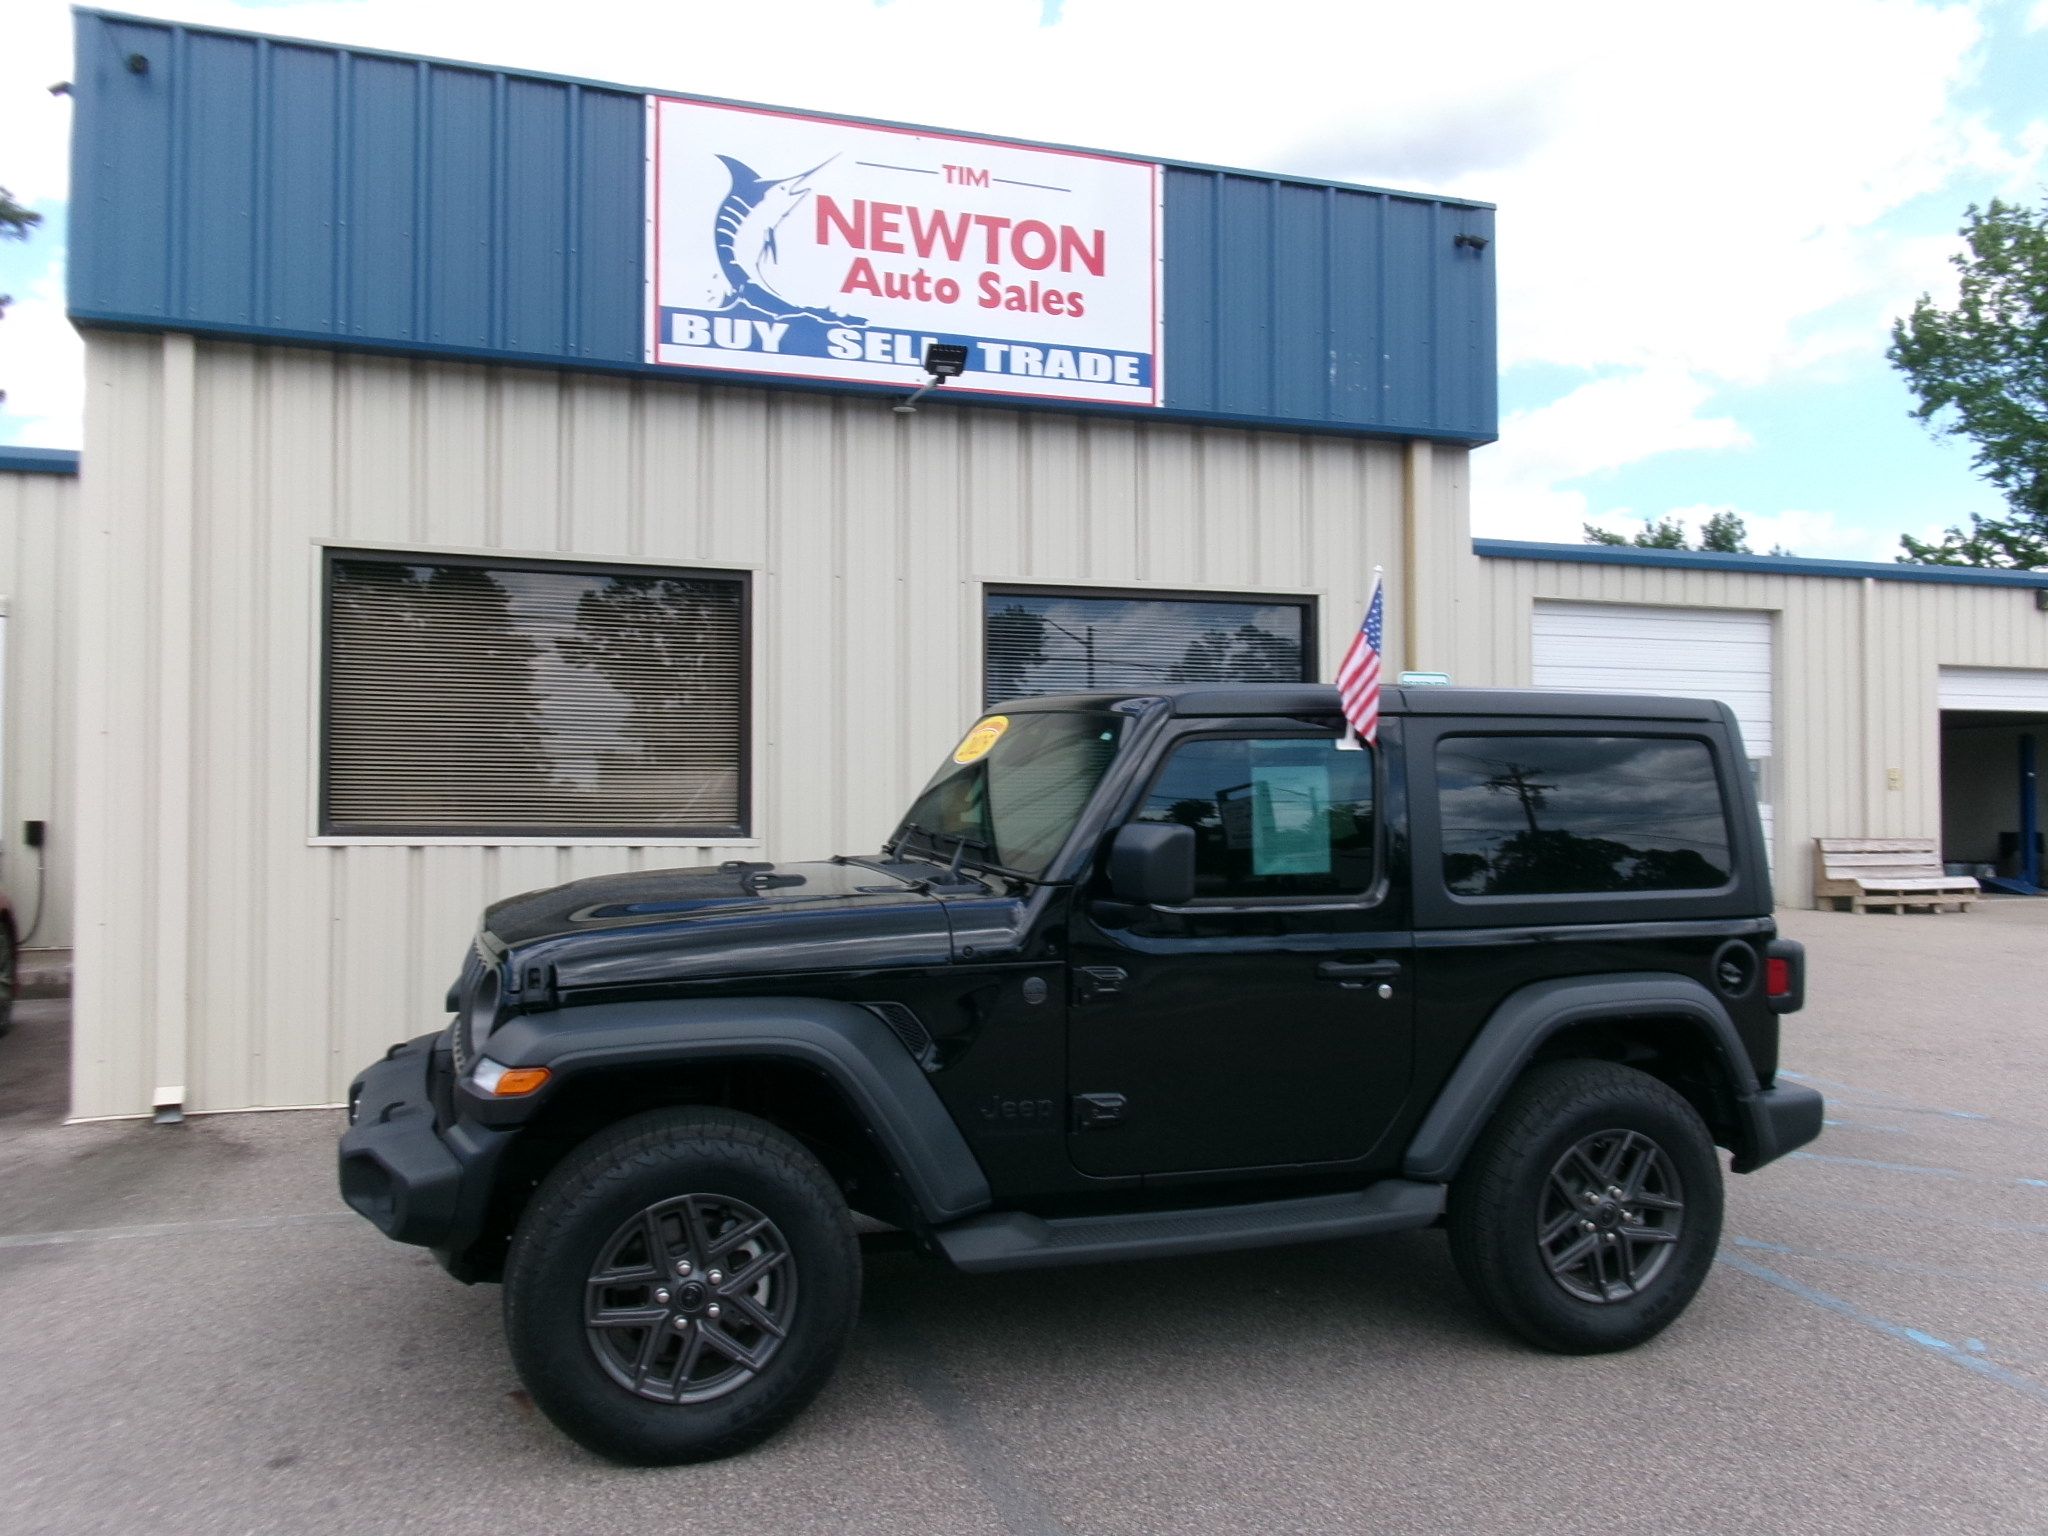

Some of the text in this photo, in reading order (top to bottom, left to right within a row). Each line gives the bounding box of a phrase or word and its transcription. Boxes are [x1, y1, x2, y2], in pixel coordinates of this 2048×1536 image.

[941, 163, 990, 189] TIM
[815, 194, 1106, 277] NEWTON
[840, 257, 1086, 318] Auto Sales
[671, 312, 789, 353] BUY
[977, 341, 1140, 386] TRADE
[979, 1095, 1053, 1119] Jeep
